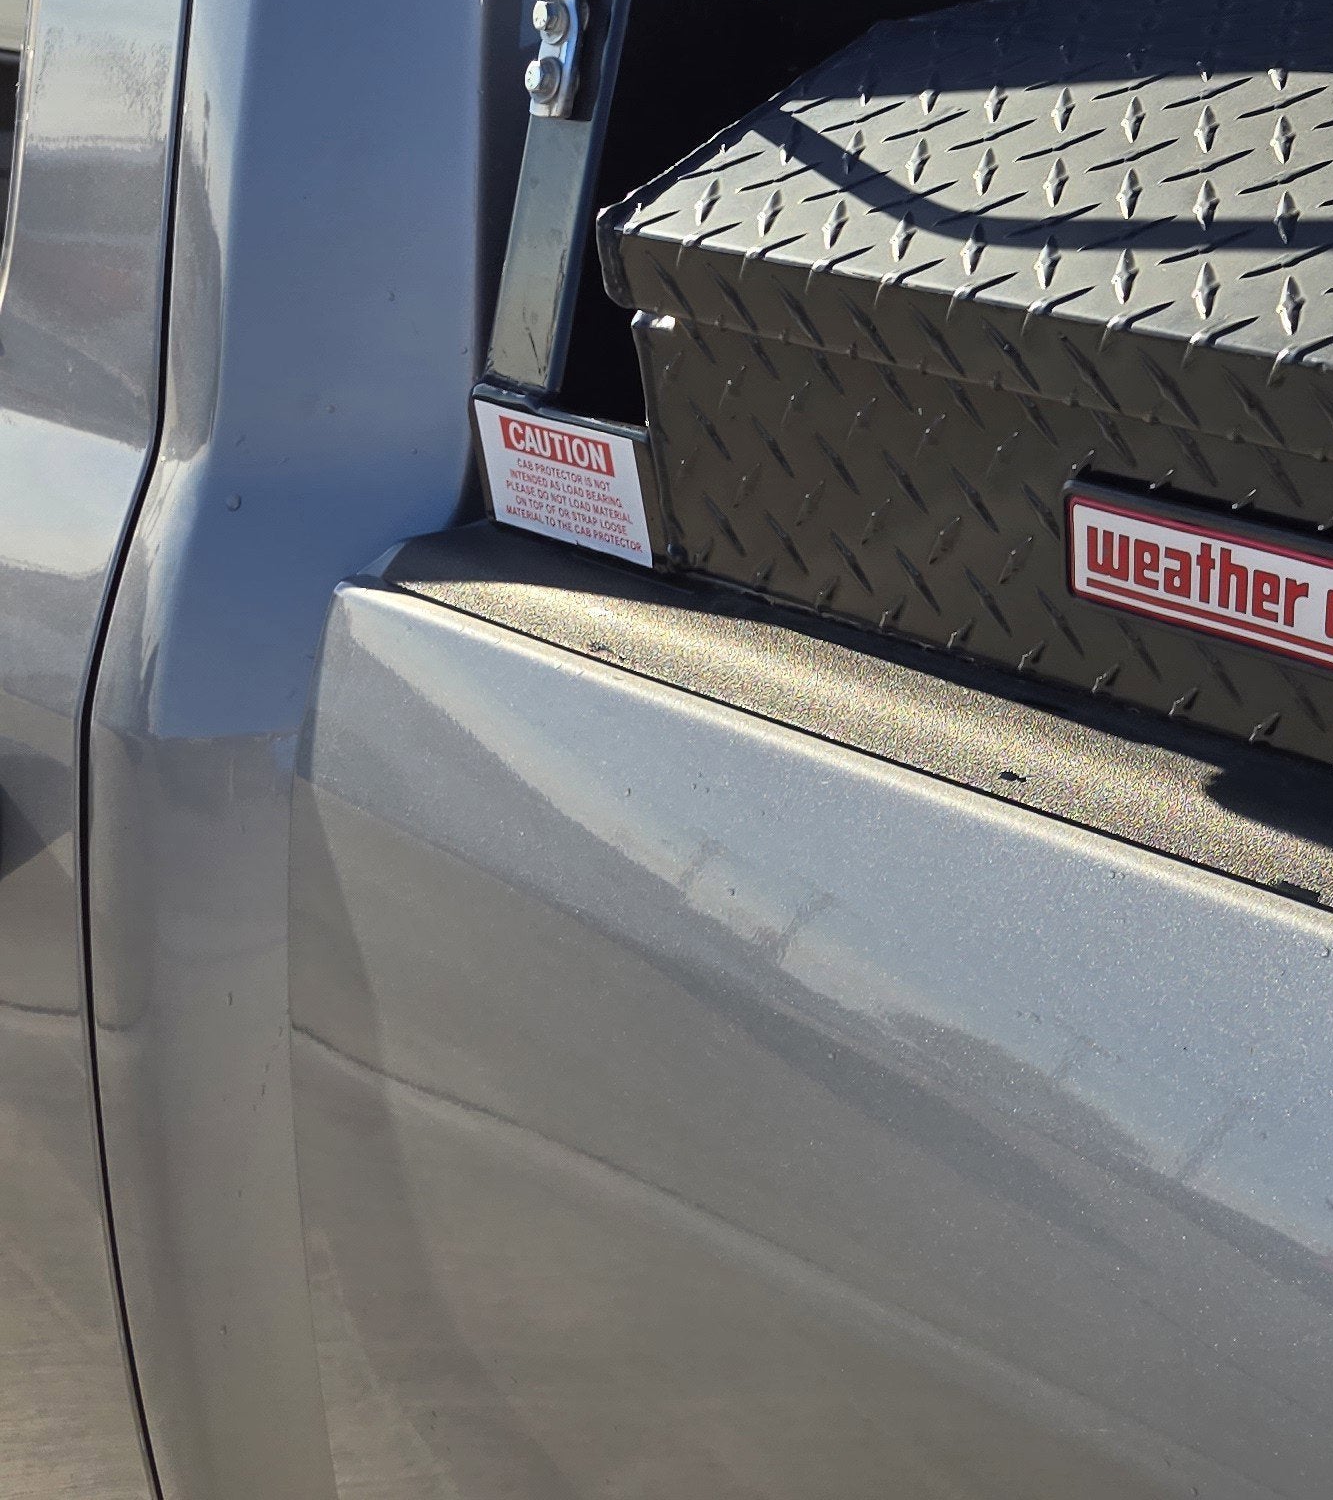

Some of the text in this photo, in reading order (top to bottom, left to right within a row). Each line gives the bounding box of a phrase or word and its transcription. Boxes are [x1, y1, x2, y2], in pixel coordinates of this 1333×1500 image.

[508, 421, 607, 473] CAUTION
[511, 469, 547, 487] INTENDED
[550, 480, 560, 491] AS
[563, 484, 584, 498] LOAD
[517, 458, 611, 493] CAB PROTECTOR IS NOT
[506, 480, 535, 496] PLEASE
[538, 489, 549, 500] DO
[551, 493, 566, 505] NOT
[569, 499, 591, 512] LOAD
[506, 504, 543, 523] MATERIAL
[545, 516, 555, 527] TO
[558, 520, 572, 532] THE
[574, 525, 591, 538] CAB
[516, 495, 627, 536] ON TOP OF OR STRAP LOOSE
[1086, 526, 1309, 627] weather
